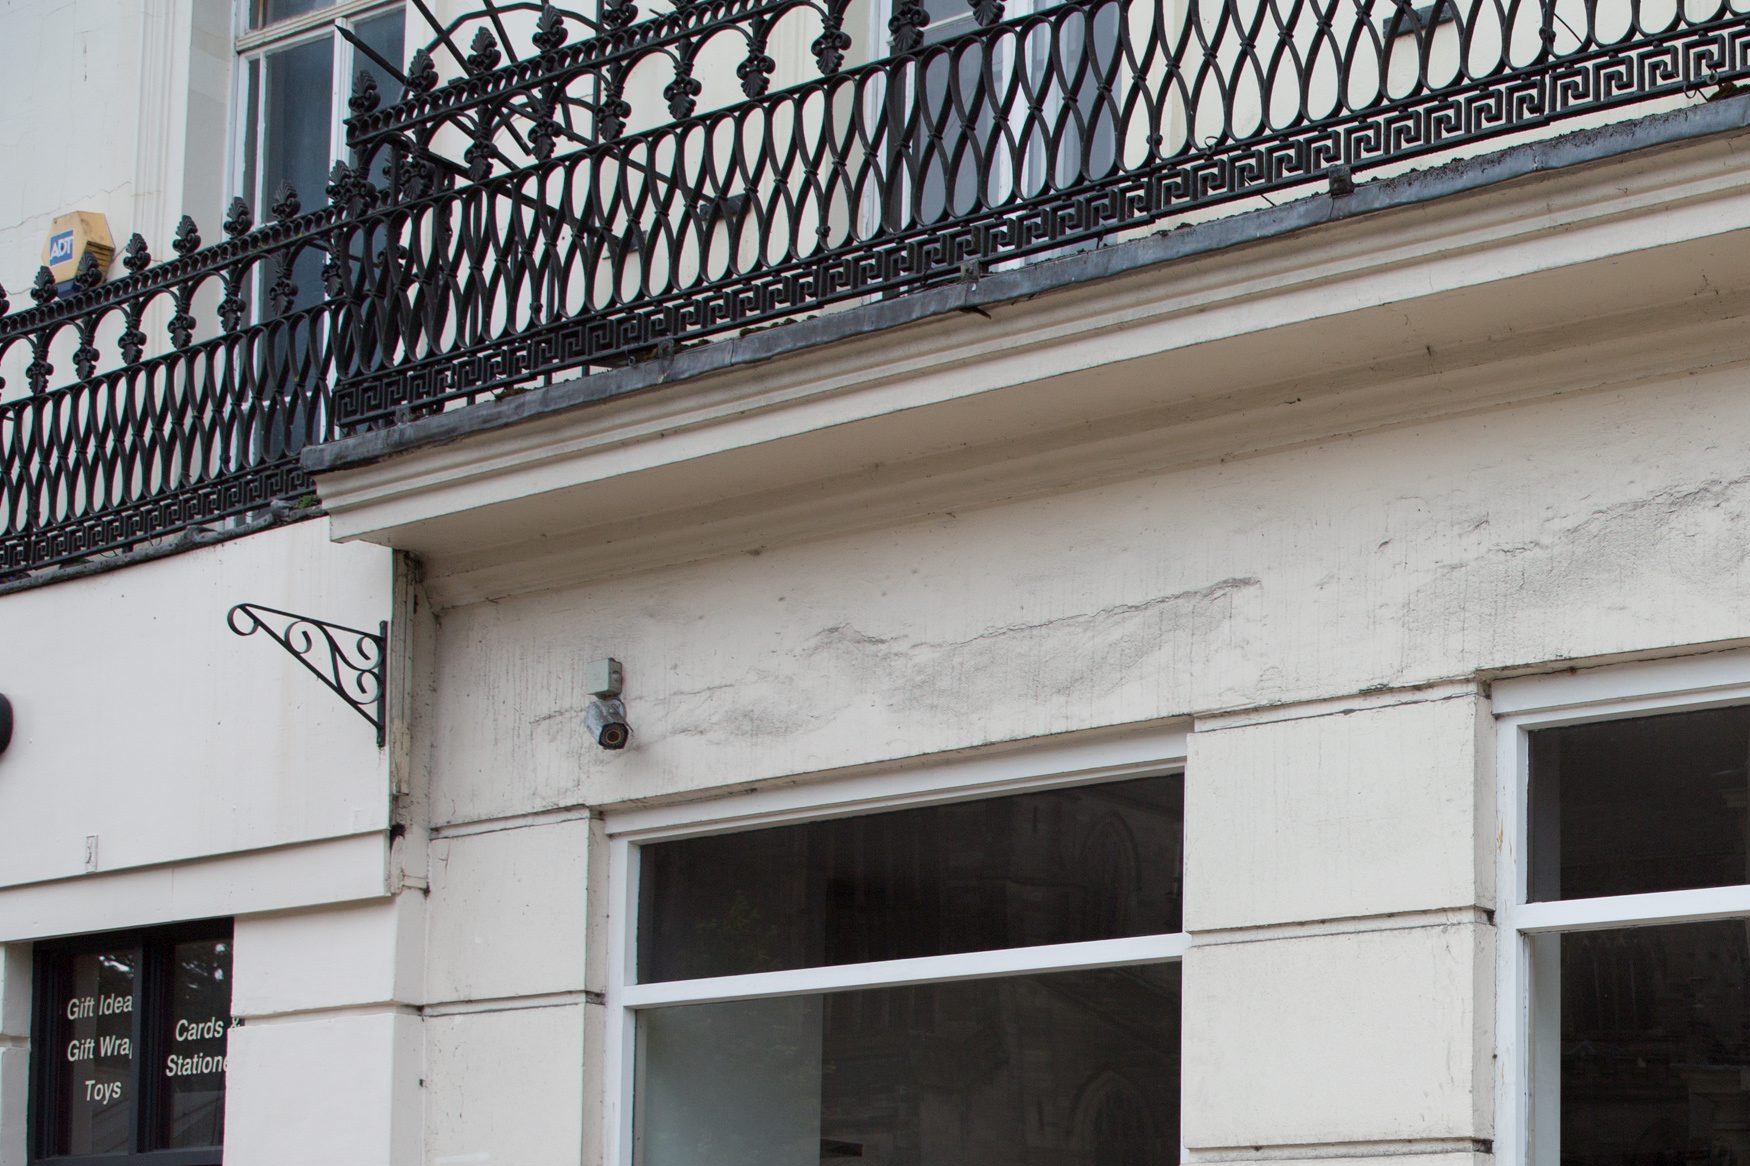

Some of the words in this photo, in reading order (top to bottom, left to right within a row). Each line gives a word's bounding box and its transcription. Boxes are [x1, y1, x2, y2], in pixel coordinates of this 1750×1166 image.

[50, 236, 73, 258] ADT
[67, 996, 95, 1020] Gift
[175, 1017, 223, 1041] Cards
[67, 1039, 95, 1062] Gift
[85, 1079, 122, 1105] Toys
